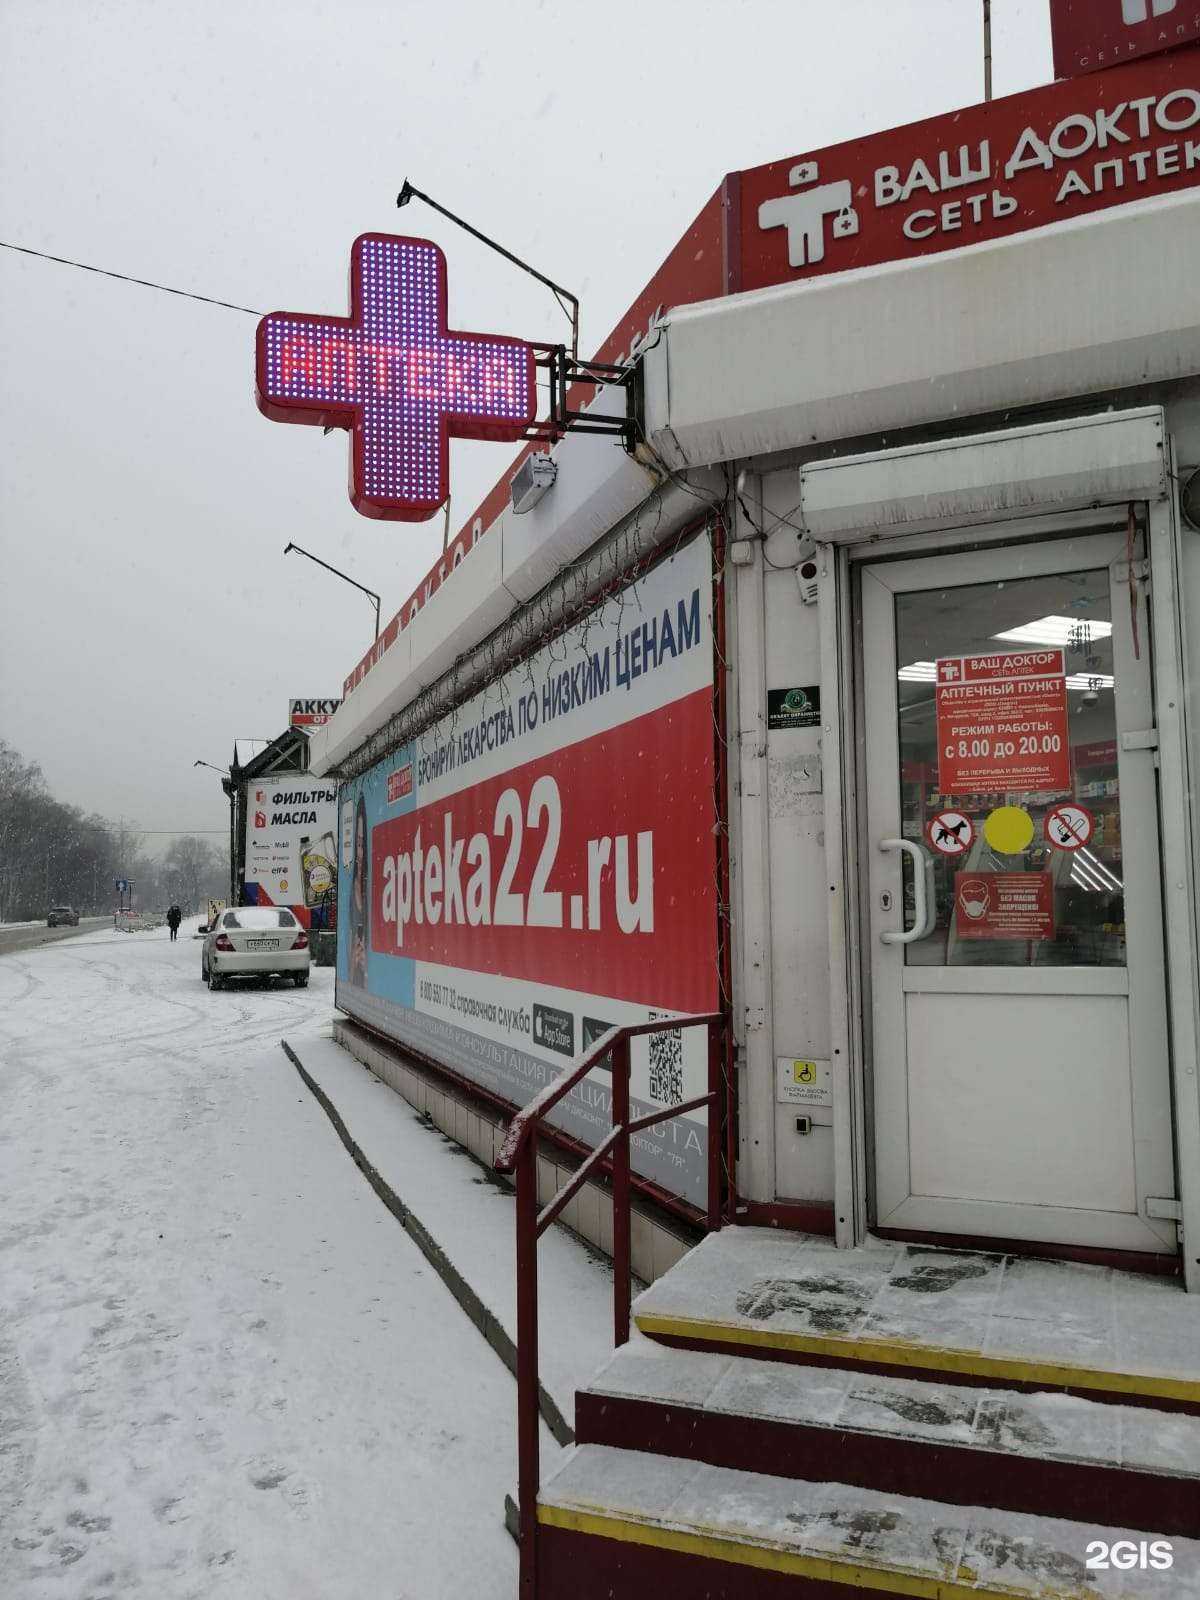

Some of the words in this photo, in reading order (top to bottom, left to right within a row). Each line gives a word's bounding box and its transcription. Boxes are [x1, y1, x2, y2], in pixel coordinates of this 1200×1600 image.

[873, 139, 991, 208] ВАШ
[1004, 88, 1200, 180] ДОКТО
[902, 188, 1018, 240] СЕТЬ
[282, 335, 515, 405] АПТЕКА
[970, 658, 1000, 670] ВАШ
[1002, 653, 1055, 668] ДОКТОР
[457, 704, 515, 767] ЛЕКАРСТВА
[518, 690, 539, 736] ПО
[542, 645, 610, 724] НИЗКИМ
[615, 587, 700, 691] ЦЕНАМ
[940, 682, 1014, 699] АПТЕЧНЫЙ
[1018, 679, 1062, 693] ПУНКТ
[292, 700, 343, 714] АККУ
[951, 725, 995, 736] РЕЖИМ
[997, 720, 1053, 734] РАБОТЫ:
[958, 739, 990, 758] 8.00
[1019, 734, 1061, 755] 20.00
[272, 790, 337, 806] ФИЛЬТРЫ
[271, 811, 317, 826] МАСЛА
[381, 775, 655, 947] apteka22.ru
[498, 1006, 531, 1034] служба
